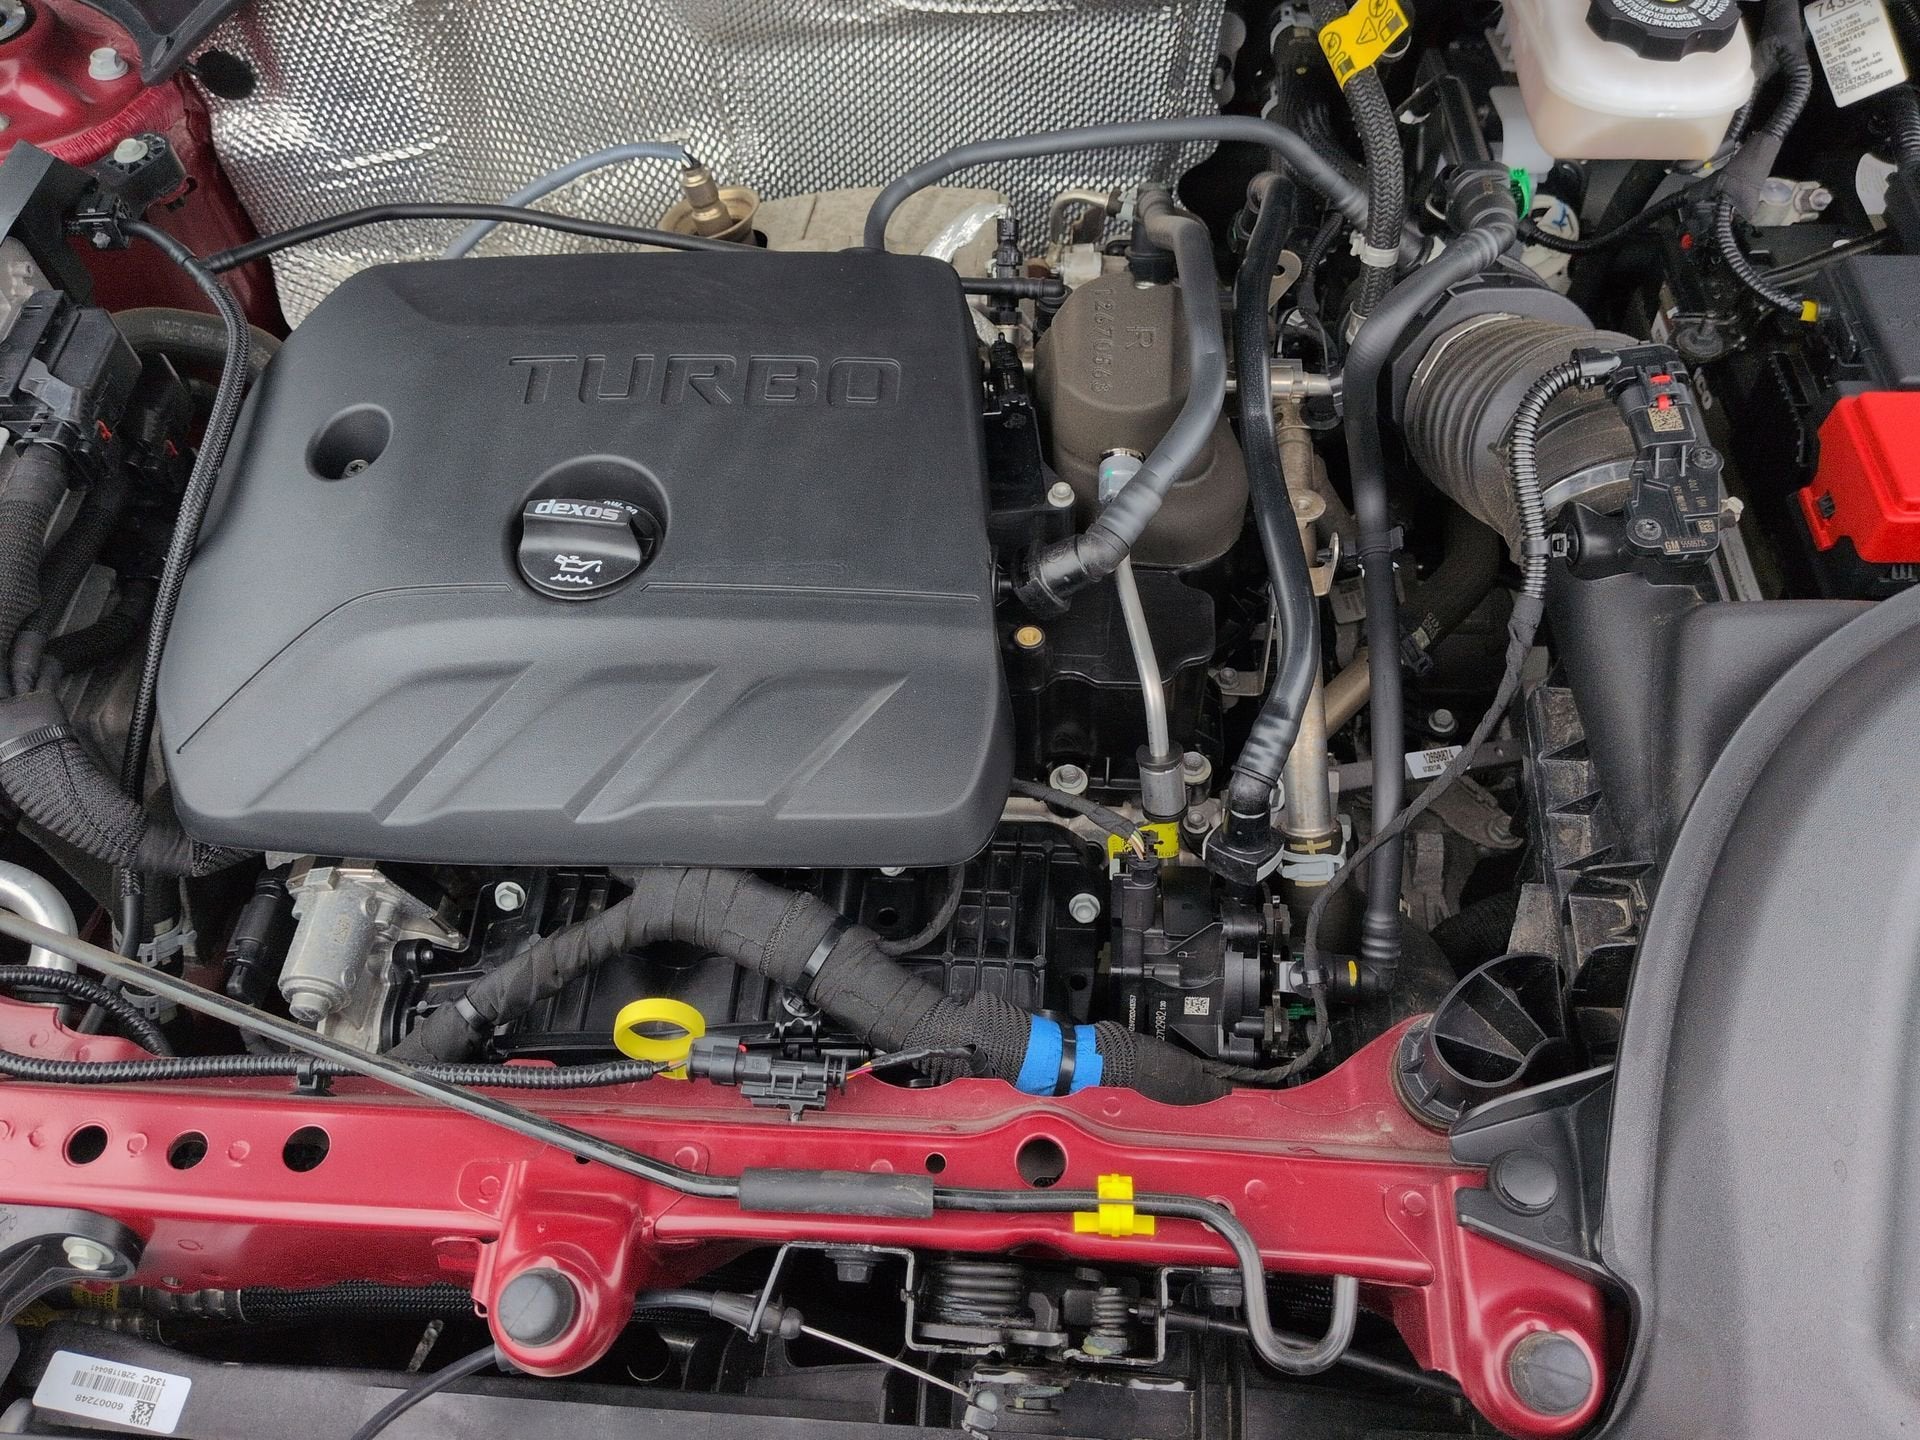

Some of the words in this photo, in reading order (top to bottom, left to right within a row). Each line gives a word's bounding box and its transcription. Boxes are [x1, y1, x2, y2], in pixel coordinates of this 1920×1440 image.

[509, 354, 901, 405] TURBO
[534, 500, 622, 521] dexos
[1665, 540, 1680, 552] GM
[142, 1375, 167, 1387] 134C
[75, 1393, 124, 1411] 60007248
